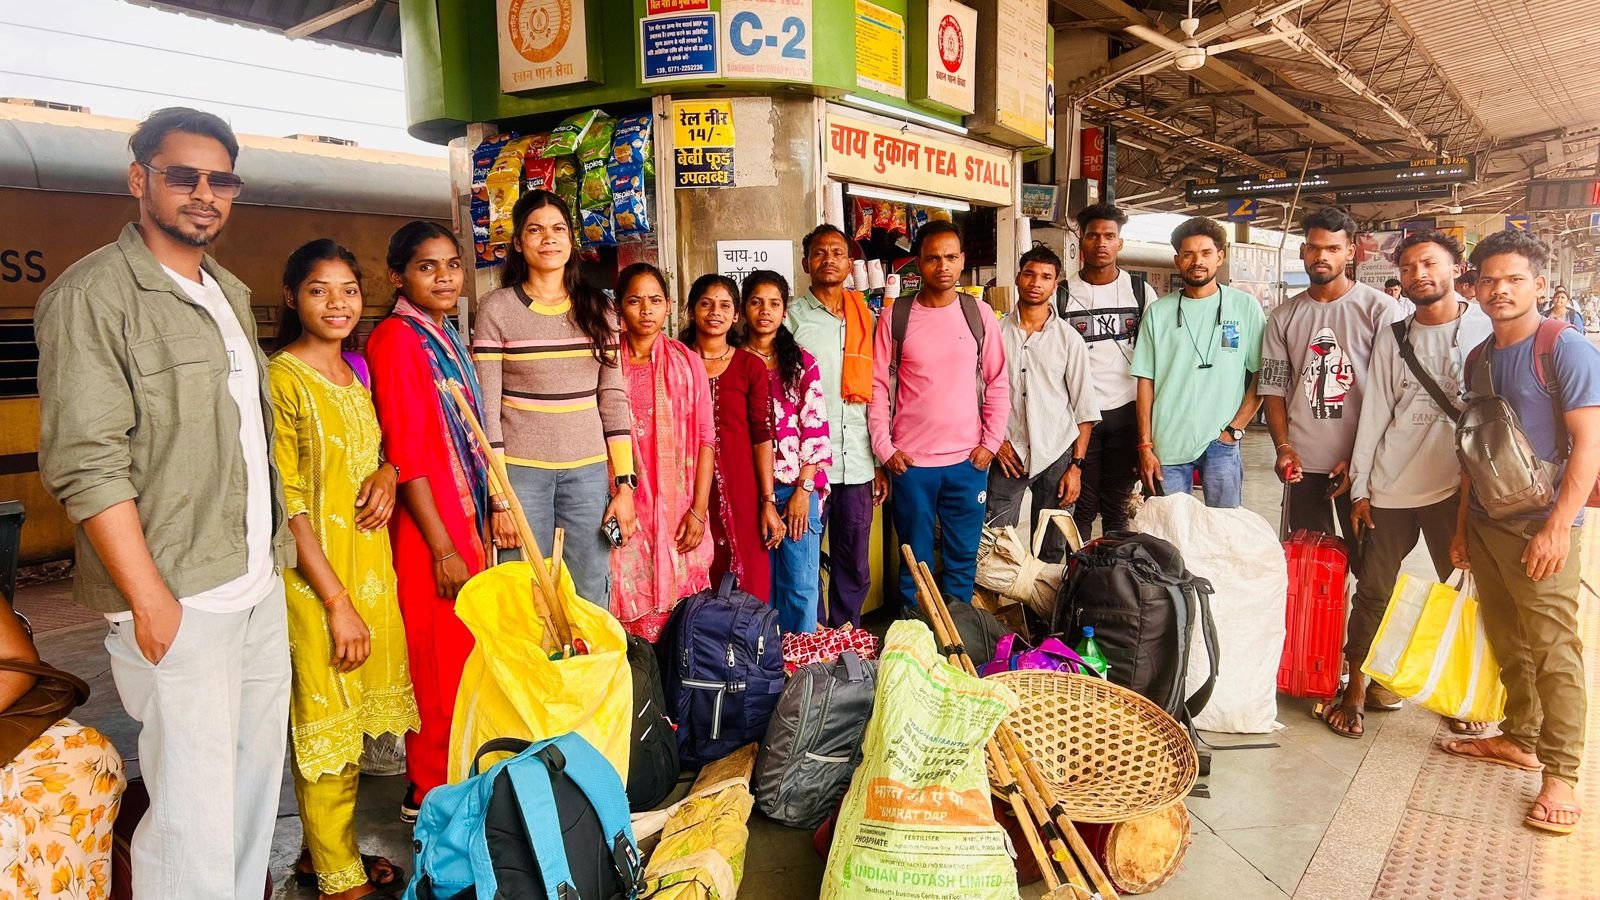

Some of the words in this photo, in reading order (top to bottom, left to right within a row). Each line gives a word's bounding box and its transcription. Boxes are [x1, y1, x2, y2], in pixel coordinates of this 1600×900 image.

[729, 11, 806, 59] C-2
[680, 108, 700, 126] रेल
[704, 108, 728, 126] नीर
[688, 128, 722, 142] 14/-
[677, 148, 704, 166] बेबी
[706, 151, 731, 169] फूड
[830, 123, 869, 158] चाय
[873, 133, 920, 174] दुकान
[924, 146, 958, 178] TEA
[964, 156, 1010, 188] STALL
[680, 170, 728, 184] उपलब्ध
[723, 250, 768, 262] चाय-10
[1301, 360, 1353, 376] vision
[891, 734, 918, 762] Jan
[875, 786, 904, 800] भारत
[924, 810, 948, 820] DAP
[854, 835, 888, 848] PHOSPHATE
[856, 864, 898, 882] INDIAN
[902, 872, 955, 888] POTASH
[960, 874, 1002, 888] LIMITED
